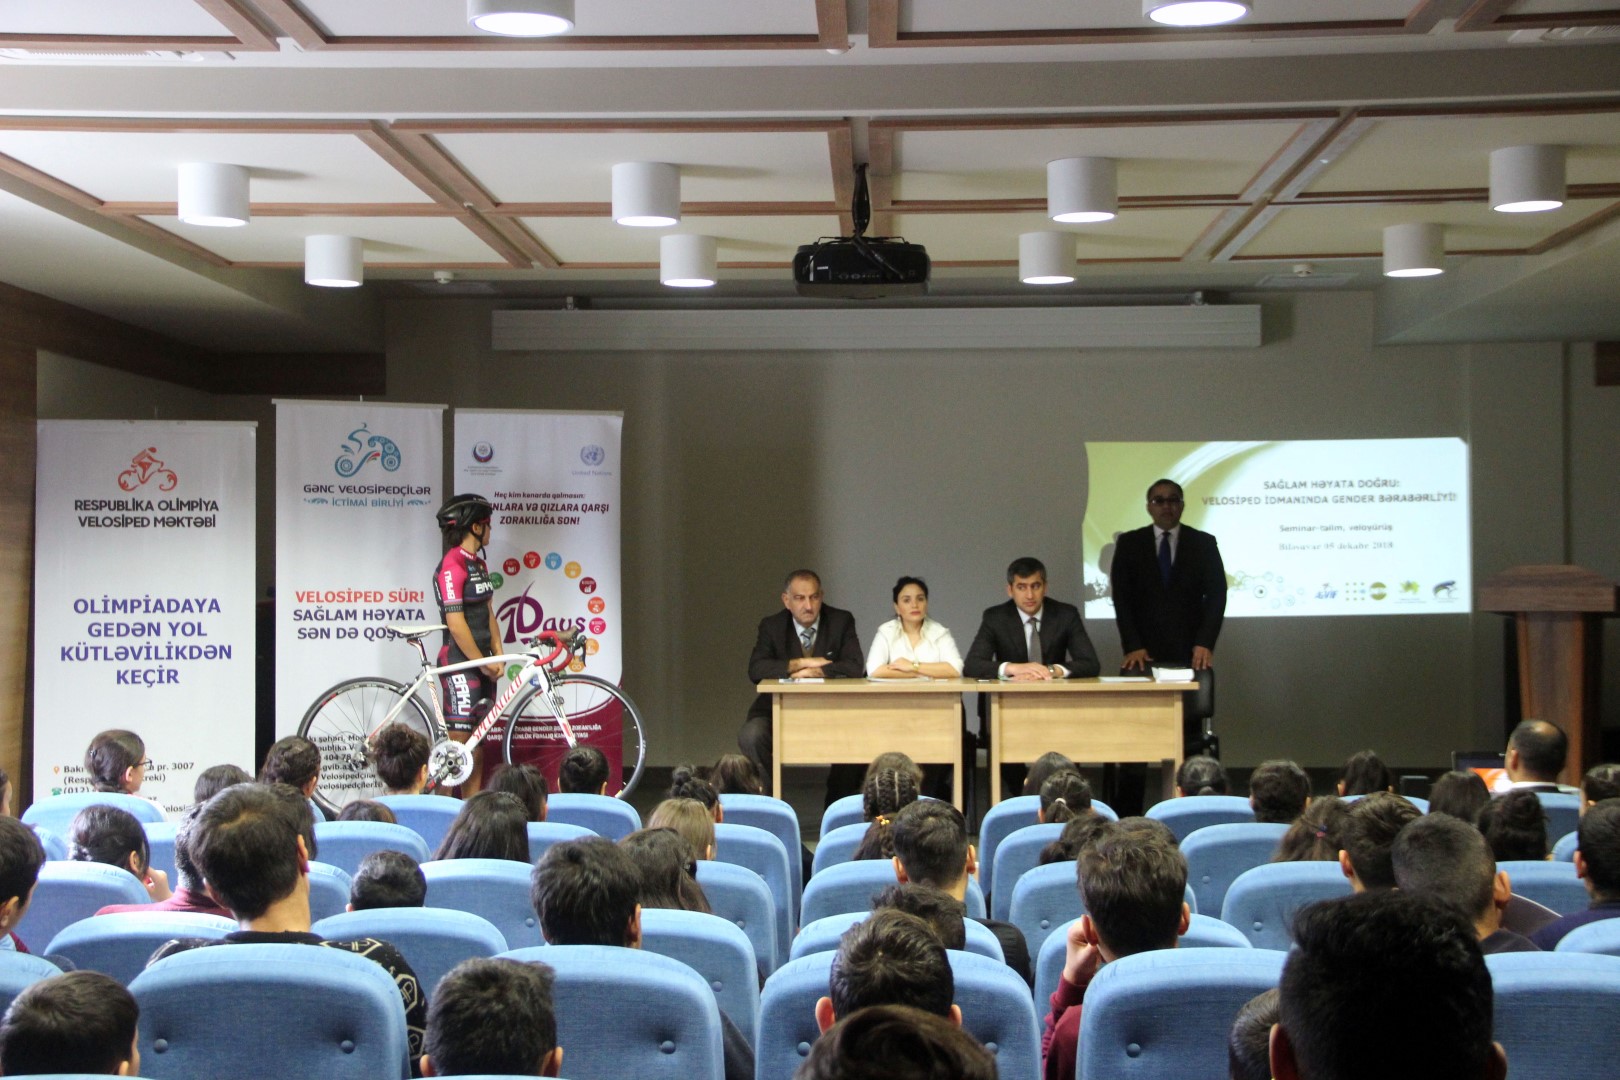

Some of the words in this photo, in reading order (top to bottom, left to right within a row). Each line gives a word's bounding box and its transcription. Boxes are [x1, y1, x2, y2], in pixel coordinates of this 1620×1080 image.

[303, 484, 334, 494] GƏNC
[494, 492, 507, 500] Heç
[74, 497, 154, 512] RESPUBLİKA
[157, 497, 219, 512] OLİMPİYA
[1332, 494, 1375, 504] GENDER
[526, 502, 538, 512] VƏ
[540, 502, 579, 513] QIZLARA
[581, 503, 610, 514] QARŞI
[78, 514, 150, 528] VELOSİPED
[153, 514, 216, 528] MƏKTƏBİ
[500, 514, 555, 525] ZORAKILIĞA
[557, 516, 580, 526] SON!
[295, 587, 384, 604] VELOSİPED
[388, 588, 425, 604] SÜR!
[73, 594, 221, 614] OLİMPİADAYA
[293, 605, 358, 621] SAĞLAM
[362, 608, 426, 621] HƏYATA
[87, 622, 161, 638] GEDƏN
[168, 621, 208, 637] YOL
[297, 627, 331, 640] SƏN
[336, 627, 359, 640] DƏ
[60, 641, 232, 662] KÜTLƏVİLİKDƏN
[116, 664, 180, 688] KEÇİR
[451, 673, 472, 716] BAKU
[172, 762, 194, 771] 3007
